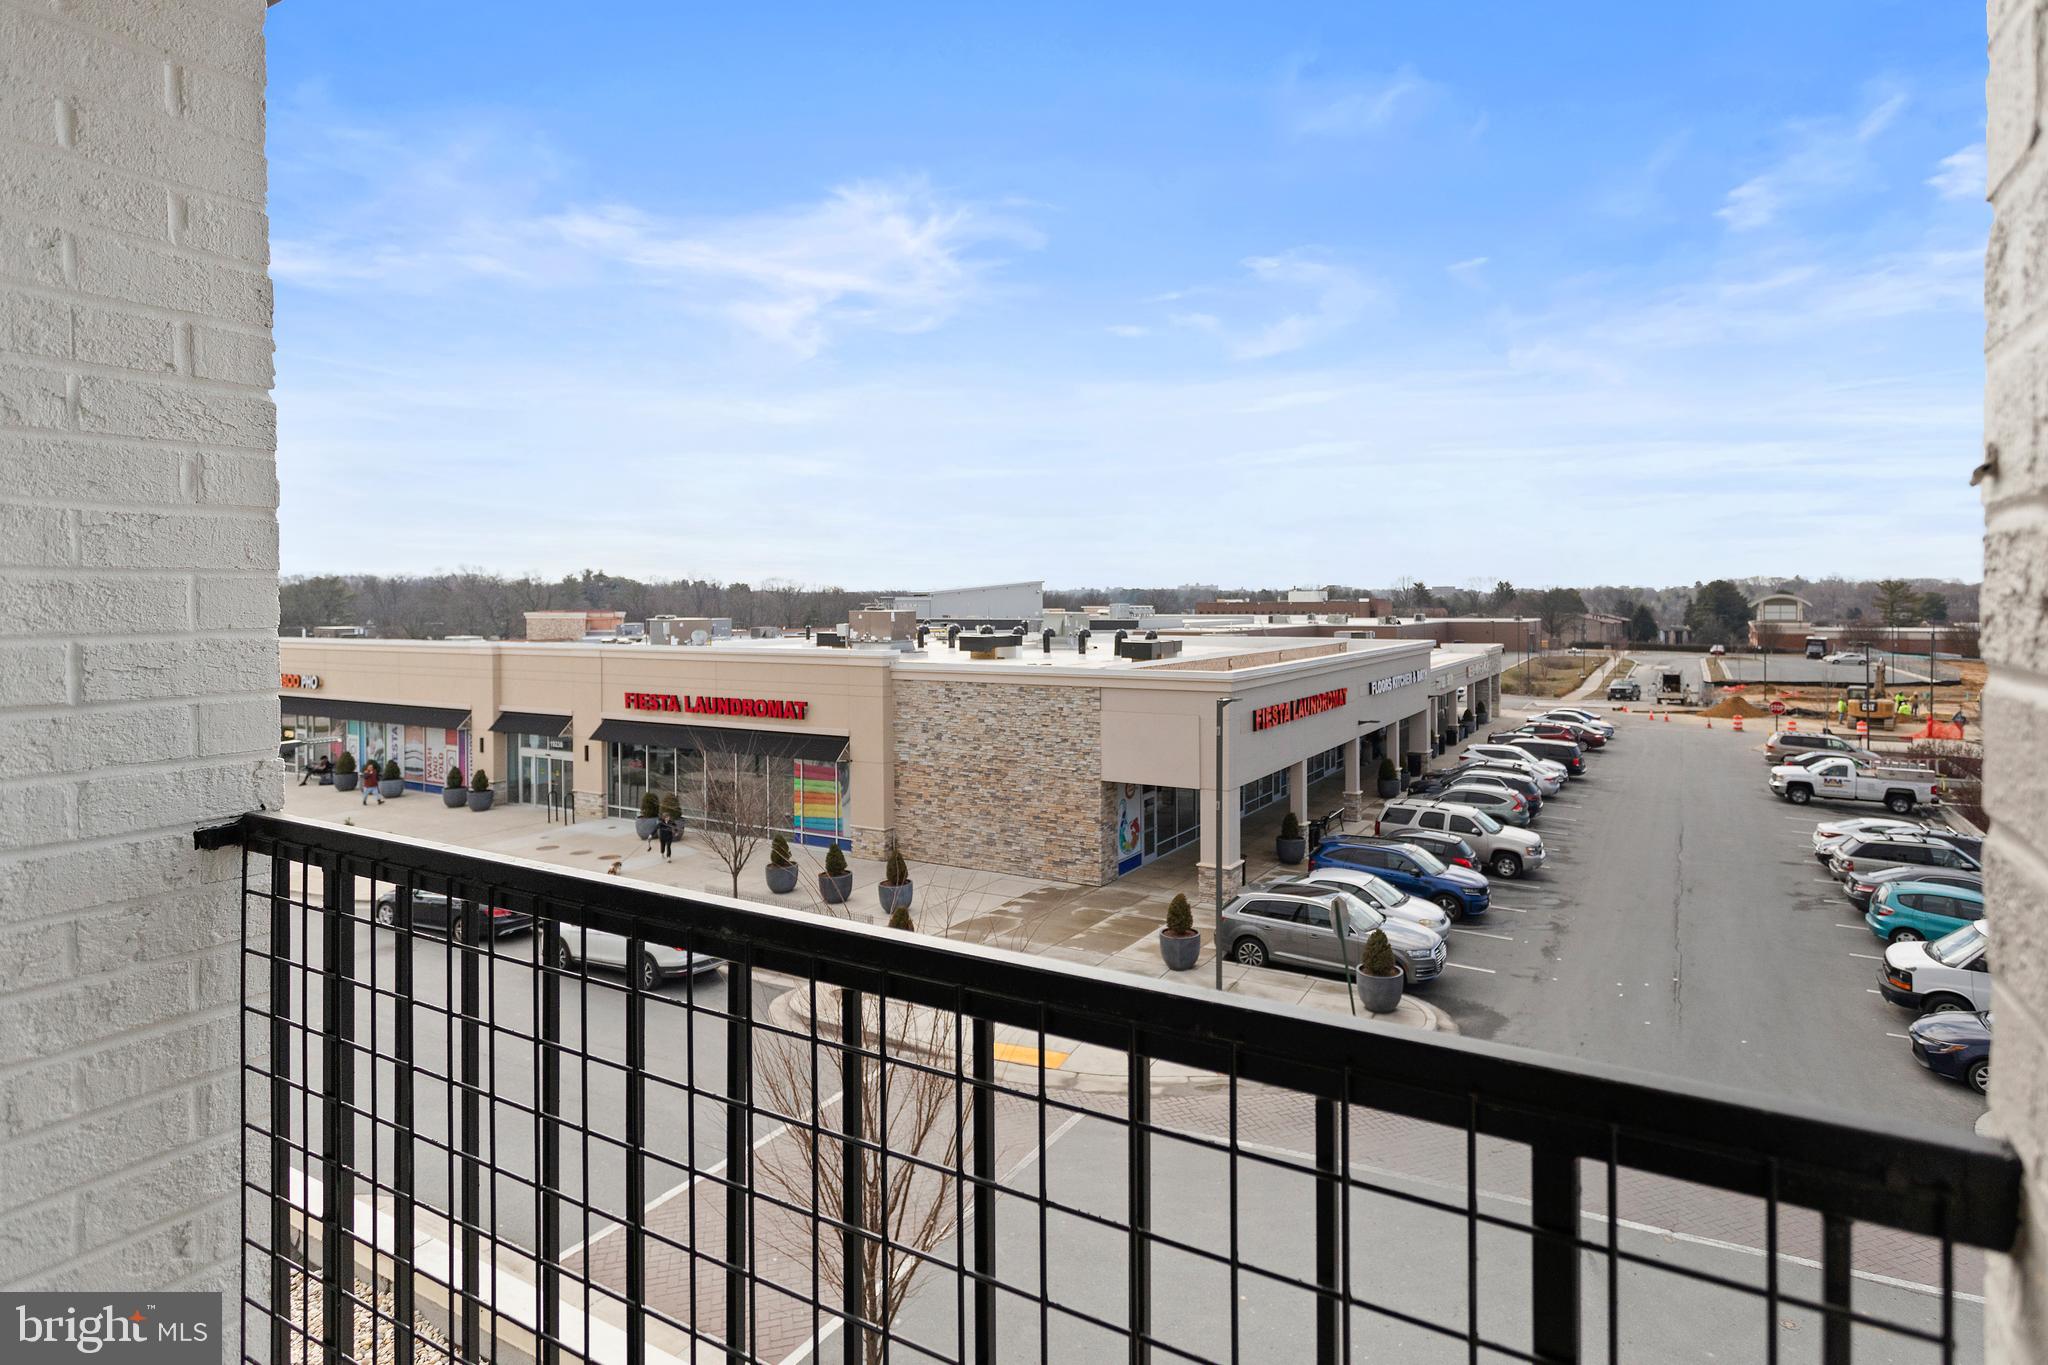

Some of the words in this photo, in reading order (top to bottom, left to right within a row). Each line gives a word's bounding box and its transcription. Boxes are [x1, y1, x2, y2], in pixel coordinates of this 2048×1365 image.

[301, 674, 320, 690] PHO
[1370, 678, 1392, 695] FLOORS
[1392, 672, 1412, 689] KITCHEN
[624, 692, 682, 713] FIESTA
[684, 695, 809, 720] LAUNDROMAT
[1253, 702, 1291, 732] FIESTA
[1291, 687, 1348, 721] LAUNDROMAT
[1861, 703, 1876, 711] CT
[391, 726, 399, 763] ESTA
